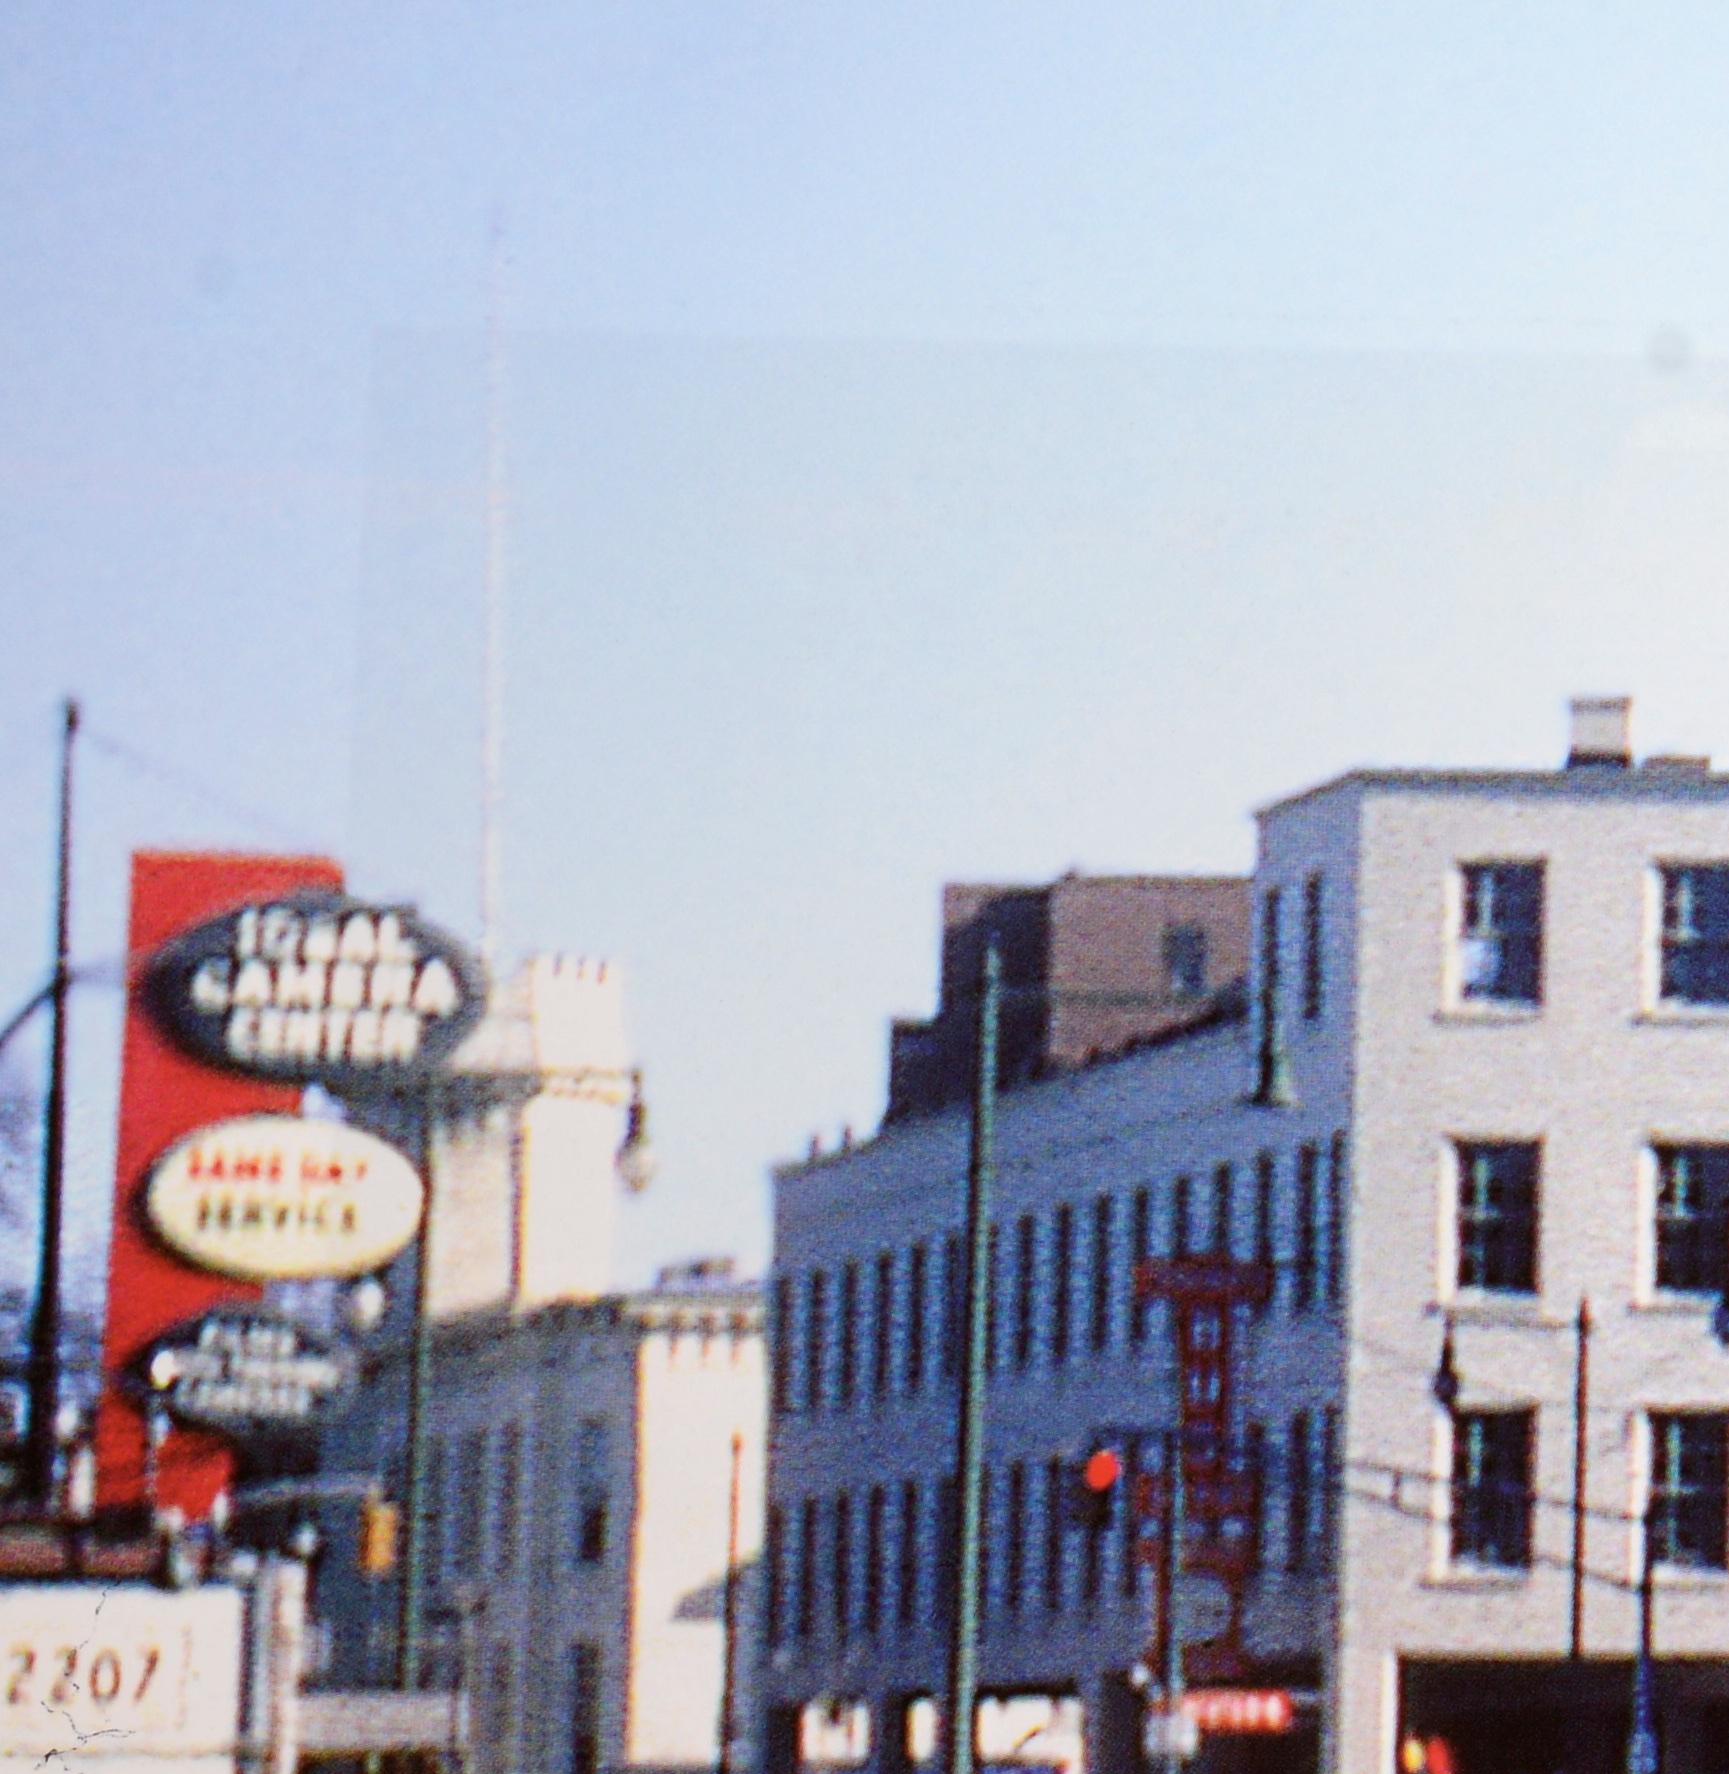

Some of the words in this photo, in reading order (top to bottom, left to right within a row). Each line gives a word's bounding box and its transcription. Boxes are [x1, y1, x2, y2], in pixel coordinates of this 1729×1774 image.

[191, 958, 460, 1018] CAMERA
[187, 1145, 282, 1180] SAME
[301, 1151, 369, 1180] DAY
[197, 1192, 357, 1233] SERVICE
[7, 1646, 160, 1703] 2207
